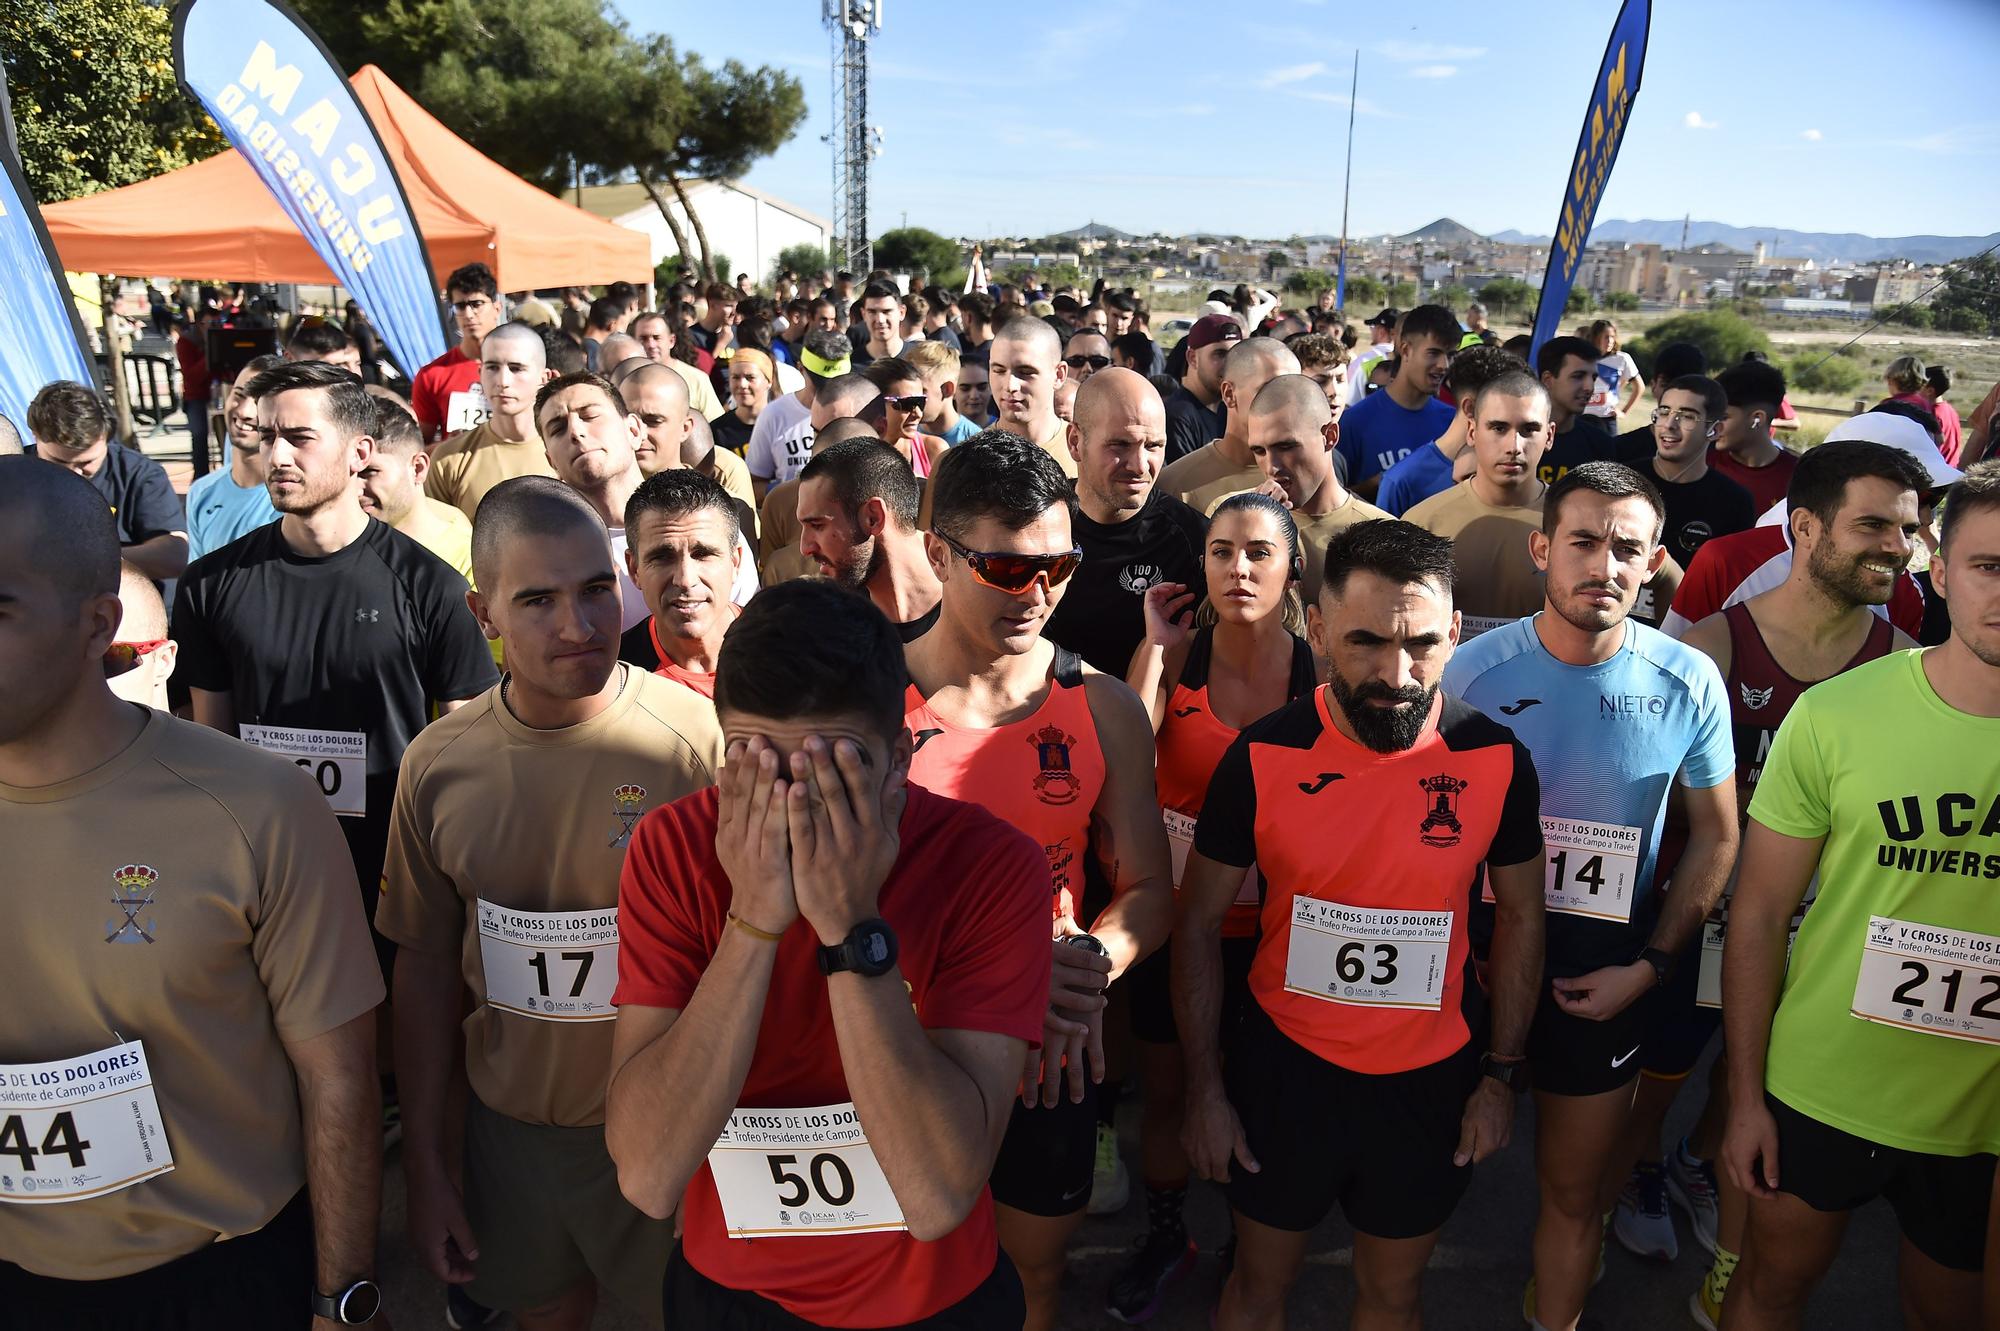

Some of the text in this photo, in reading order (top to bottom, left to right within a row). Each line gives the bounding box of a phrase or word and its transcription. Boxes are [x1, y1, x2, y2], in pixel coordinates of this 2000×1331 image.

[1559, 41, 1627, 251] UCAM
[1134, 564, 1152, 576] 100
[1600, 694, 1667, 714] NIETO
[269, 731, 294, 742] CROSS
[296, 734, 306, 743] DE
[308, 735, 323, 744] LOS
[326, 736, 363, 746] DOLORES
[280, 742, 308, 752] Presidente
[310, 744, 318, 752] de
[319, 745, 338, 755] Campo
[345, 746, 363, 755] Través
[295, 758, 341, 796] 0
[1558, 823, 1569, 833] DE
[1572, 825, 1590, 835] LOS
[1593, 827, 1637, 842] DOLORES
[1573, 835, 1582, 845] de
[1583, 837, 1607, 848] Campo
[1613, 841, 1635, 852] Través
[1550, 850, 1606, 896] 14
[501, 913, 507, 925] V
[511, 916, 545, 930] CROSS
[548, 919, 563, 931] DE
[566, 918, 587, 930] LOS
[1320, 906, 1448, 927] V CROSS DE LOS DOLORES
[502, 926, 524, 940] Trofeo
[525, 931, 568, 943] Presidente
[570, 931, 580, 942] de
[582, 930, 610, 942] Campo
[612, 929, 618, 937] a
[1318, 918, 1341, 931] Trofeo
[1342, 923, 1380, 936] Presidente
[1381, 926, 1391, 936] de
[1392, 927, 1417, 938] Campo
[1424, 928, 1446, 938] Través
[1871, 934, 1893, 943] UCAM
[1900, 927, 1908, 938] V
[1911, 929, 1949, 945] CROSS
[1951, 936, 1966, 948] DE
[1969, 939, 1992, 952] LOS
[1897, 940, 1923, 953] Trofeo
[1924, 944, 1968, 961] Presidente
[1969, 952, 1980, 963] de
[528, 950, 595, 998] 17
[1335, 942, 1399, 986] 63
[1891, 960, 2000, 1021] 212
[10, 1073, 28, 1087] DE
[31, 1070, 60, 1086] LOS
[64, 1051, 140, 1082] DOLORES
[40, 1089, 54, 1101] de
[56, 1083, 96, 1099] Campo
[98, 1081, 106, 1090] a
[106, 1069, 143, 1088] Través
[730, 1116, 738, 1128] V
[742, 1115, 782, 1128] CROSS
[785, 1116, 801, 1129] DE
[804, 1114, 829, 1128] LOS
[734, 1131, 762, 1143] Trofeo
[763, 1131, 810, 1144] Presidente
[812, 1129, 825, 1142] de
[826, 1127, 860, 1143] Campo
[766, 1152, 855, 1208] 50
